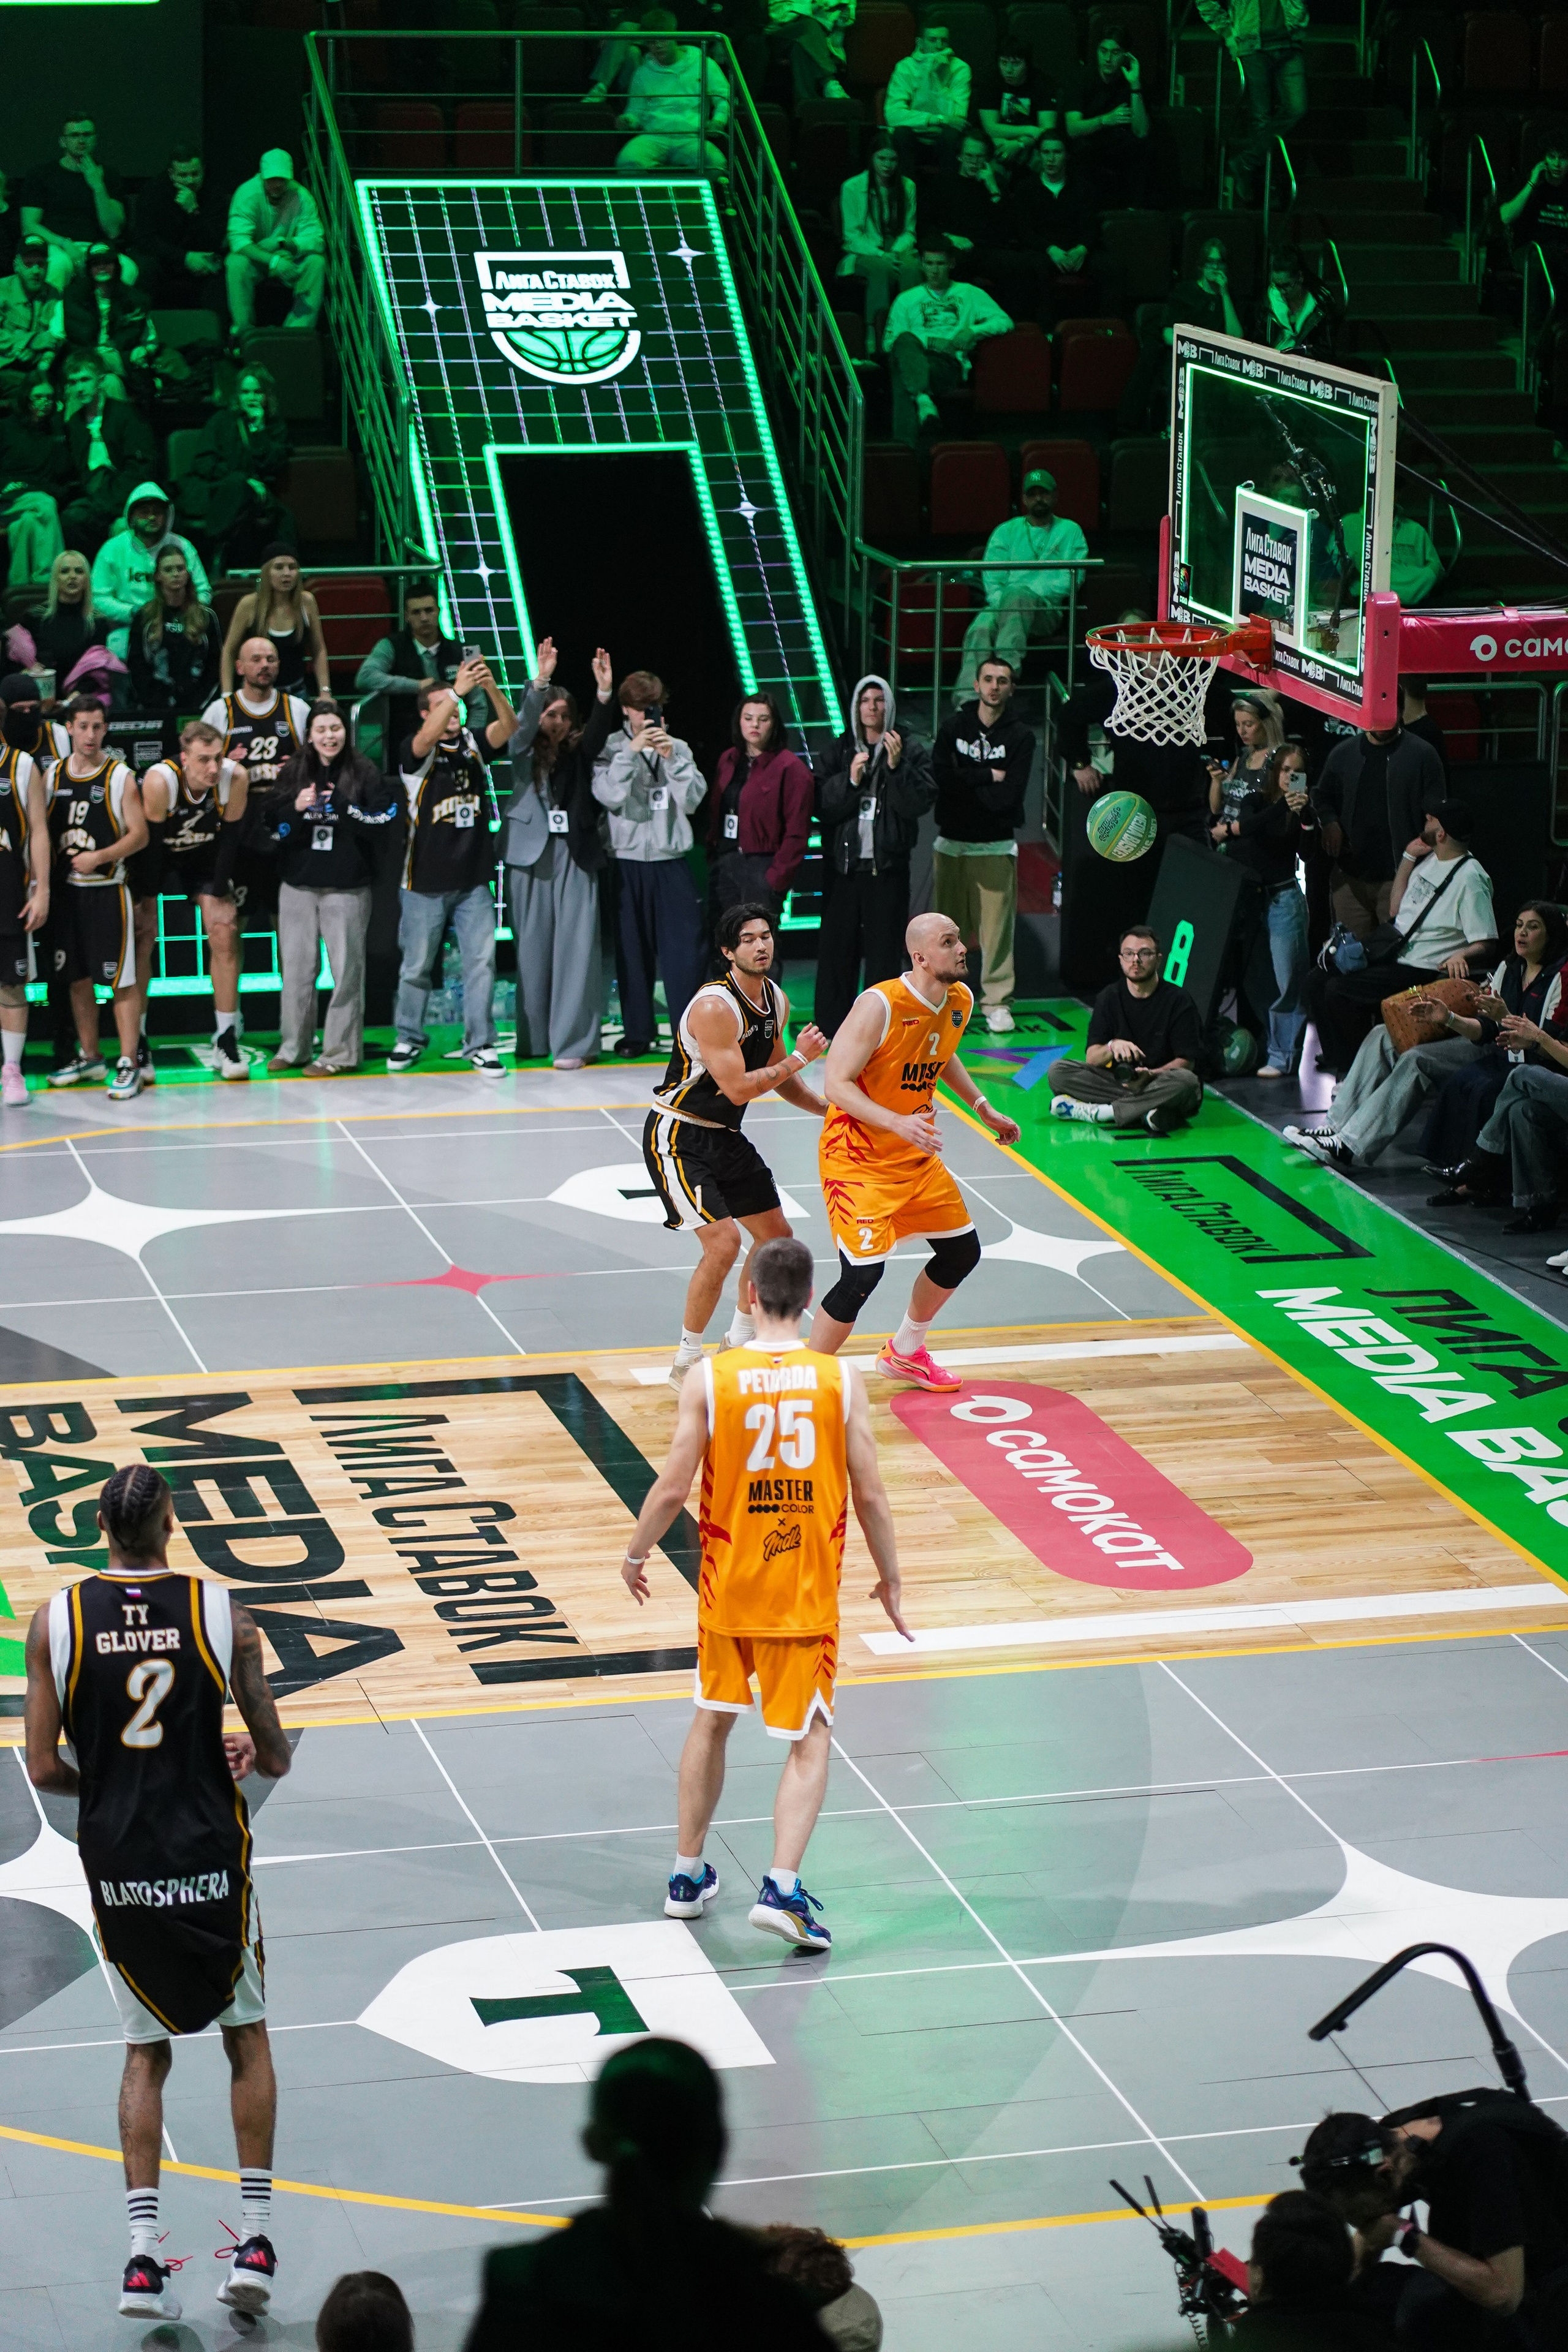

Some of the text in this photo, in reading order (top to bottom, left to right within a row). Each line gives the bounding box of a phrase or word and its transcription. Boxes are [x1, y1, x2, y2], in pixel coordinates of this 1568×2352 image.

[481, 292, 635, 312] MEDIA
[486, 312, 638, 328] BASKET
[1245, 553, 1290, 589] MEDIA
[1244, 575, 1290, 605] BASKET
[1504, 637, 1568, 658] сам
[248, 736, 279, 760] 23
[68, 801, 90, 825] 19
[1112, 812, 1147, 858] MEDIA BASKET
[929, 1033, 940, 1056] 2
[859, 1227, 873, 1251] 2
[1255, 1287, 1496, 1423] MEDIA
[1362, 1288, 1568, 1400] ЛИГА
[738, 1365, 818, 1395] PETARDA
[745, 1400, 816, 1471] 25
[748, 1479, 814, 1502] MASTER
[986, 1430, 1185, 1570] самокат
[781, 1504, 815, 1514] COLOR
[115, 1391, 405, 1700] MEDIA
[122, 1604, 149, 1626] TY
[96, 1628, 181, 1654] GLOVER
[121, 1659, 175, 1749] 2
[100, 1870, 230, 1907] BLATOSPHERA
